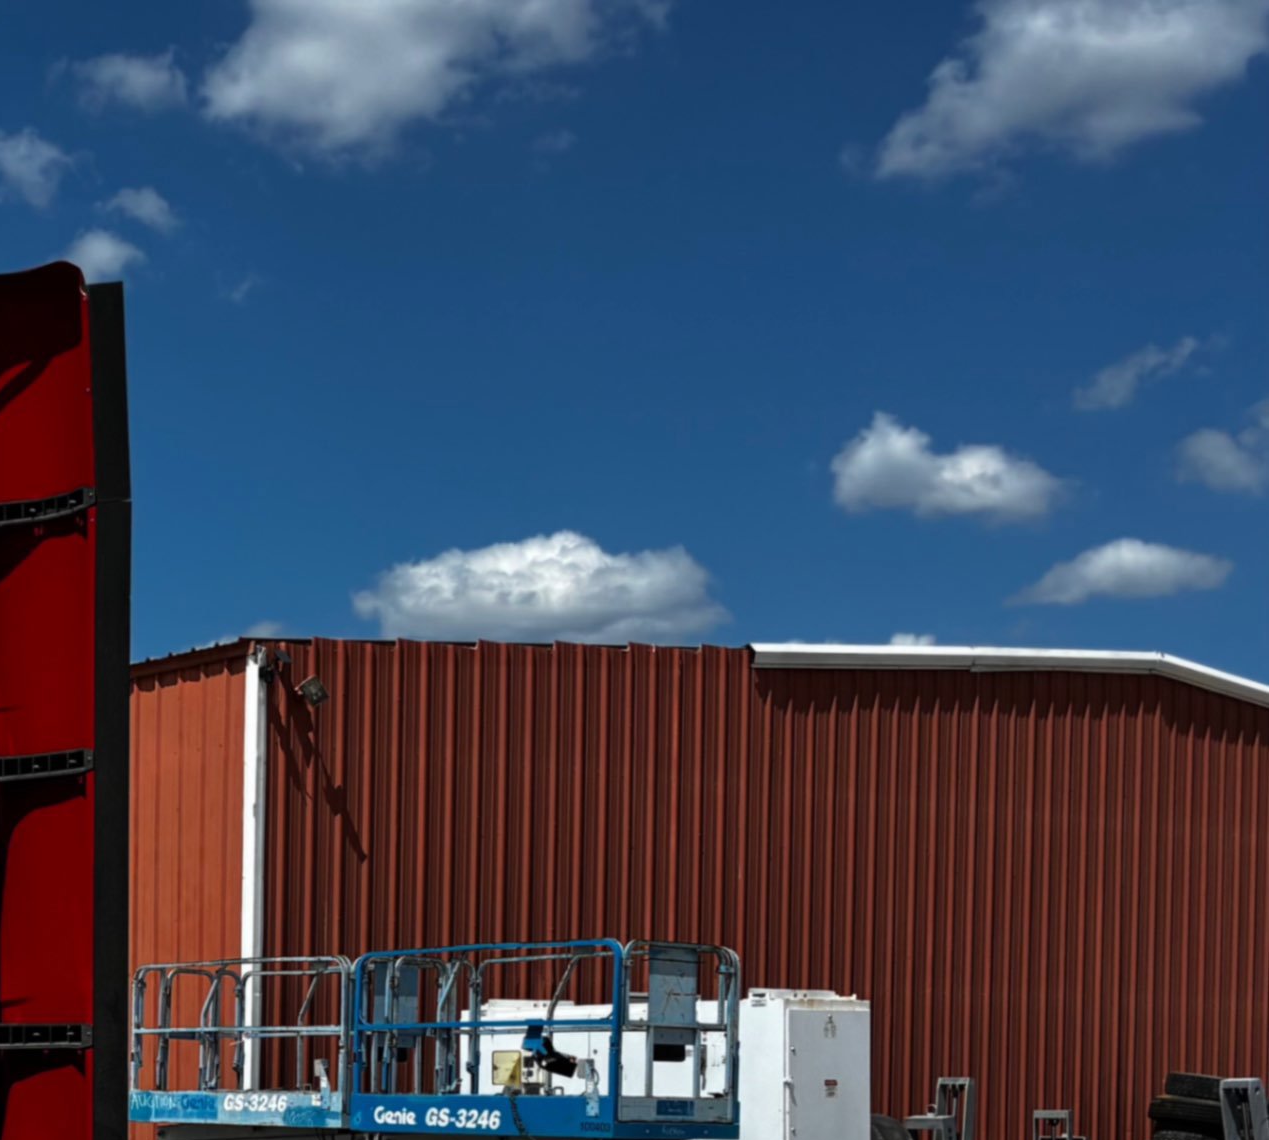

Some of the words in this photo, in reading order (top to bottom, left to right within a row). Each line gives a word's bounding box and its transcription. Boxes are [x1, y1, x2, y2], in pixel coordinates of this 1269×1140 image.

[223, 1094, 287, 1112] GS-3246
[374, 1106, 416, 1125] Genie
[425, 1107, 501, 1130] GS-3246
